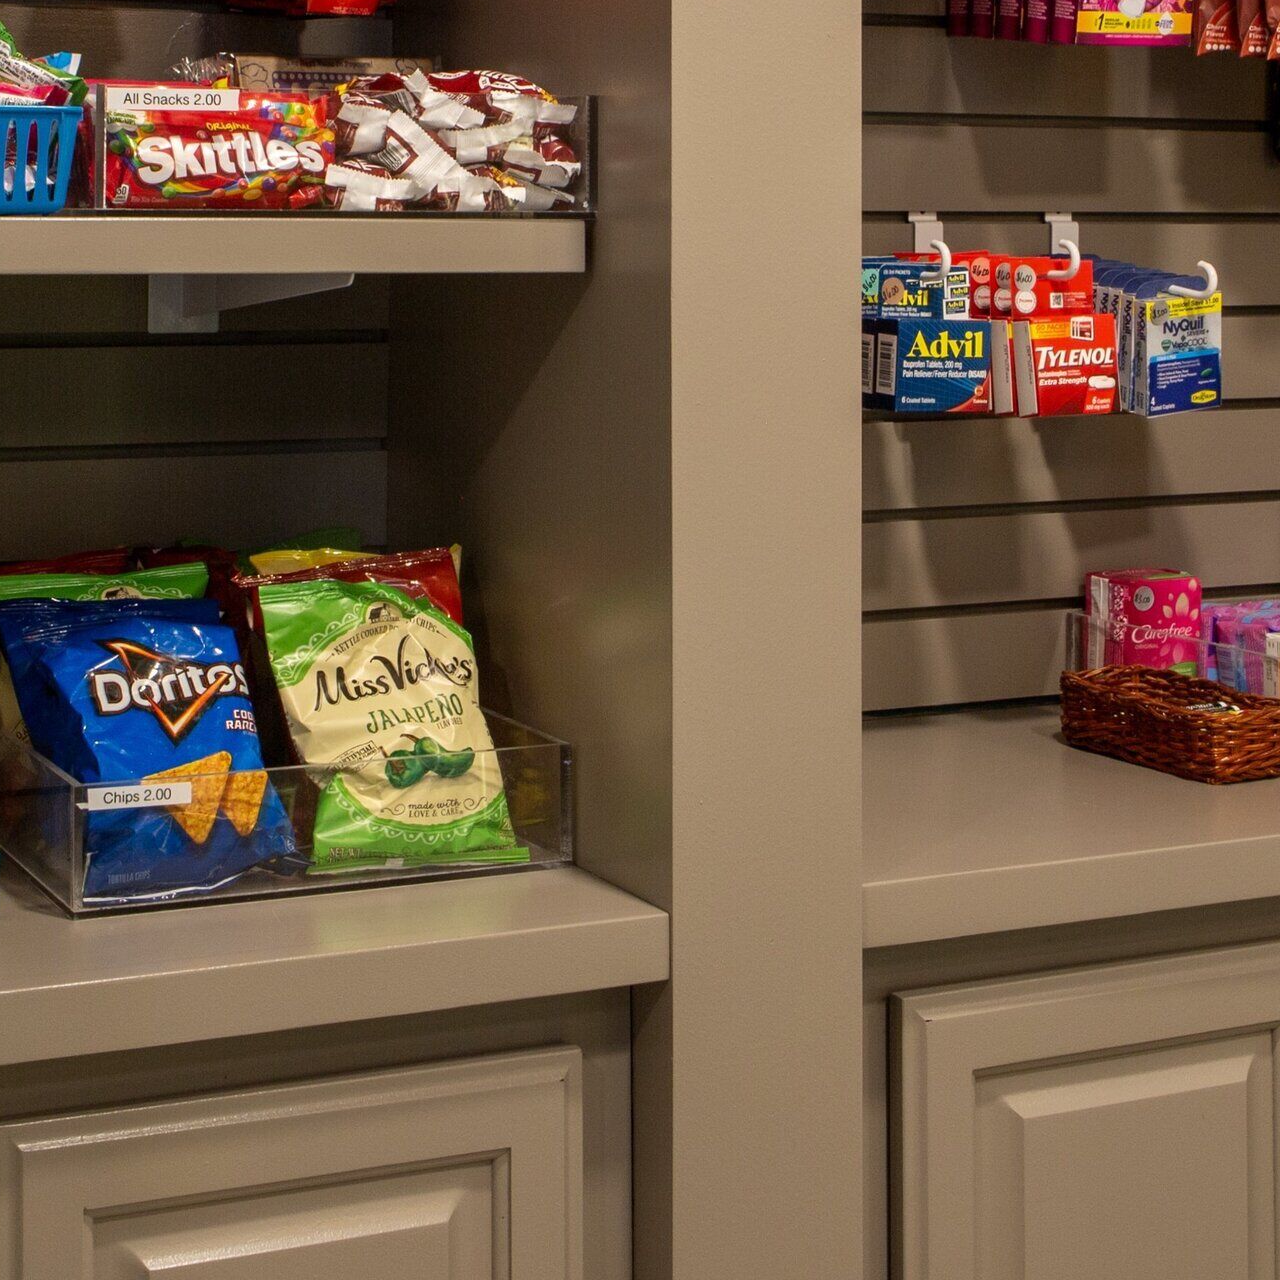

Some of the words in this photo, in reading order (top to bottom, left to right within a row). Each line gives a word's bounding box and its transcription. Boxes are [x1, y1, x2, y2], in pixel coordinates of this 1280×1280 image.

[123, 93, 142, 105] All
[144, 93, 190, 106] Snacks
[194, 93, 222, 106] 2.00
[135, 130, 324, 185] Skittles
[946, 301, 964, 309] Advil
[1163, 316, 1205, 336] NyQuil
[906, 330, 983, 359] Advil
[1035, 347, 1113, 369] TYLENOL
[903, 370, 913, 378] Pain
[948, 370, 967, 378] Reducer
[1151, 397, 1155, 405] 4
[1131, 622, 1192, 643] Carefree
[92, 663, 250, 715] Doritos
[315, 666, 389, 711] Miss
[367, 693, 463, 733] JALAPEÑO
[103, 792, 140, 805] Chips
[143, 788, 172, 802] 2.00
[408, 800, 440, 810] made
[444, 798, 462, 808] with
[409, 808, 431, 818] LOVE
